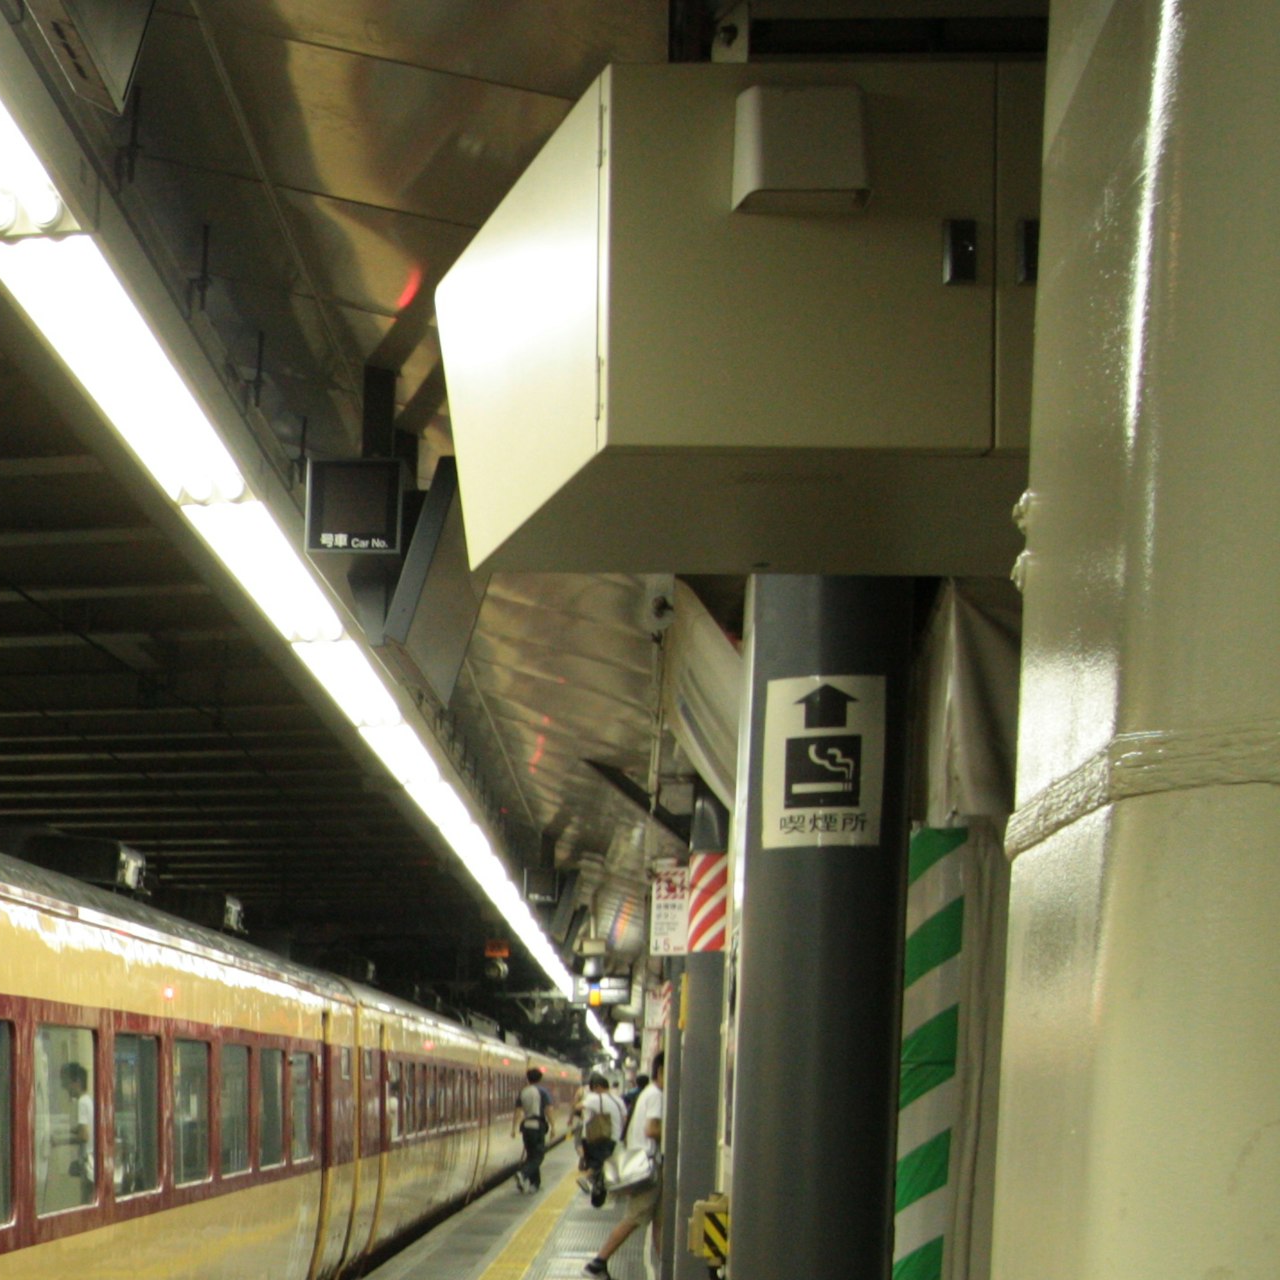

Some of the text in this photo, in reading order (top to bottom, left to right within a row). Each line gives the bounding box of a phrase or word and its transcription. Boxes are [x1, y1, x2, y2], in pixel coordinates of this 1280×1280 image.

[351, 537, 369, 548] Car
[371, 537, 388, 548] No.
[779, 812, 867, 834] 喫煙所
